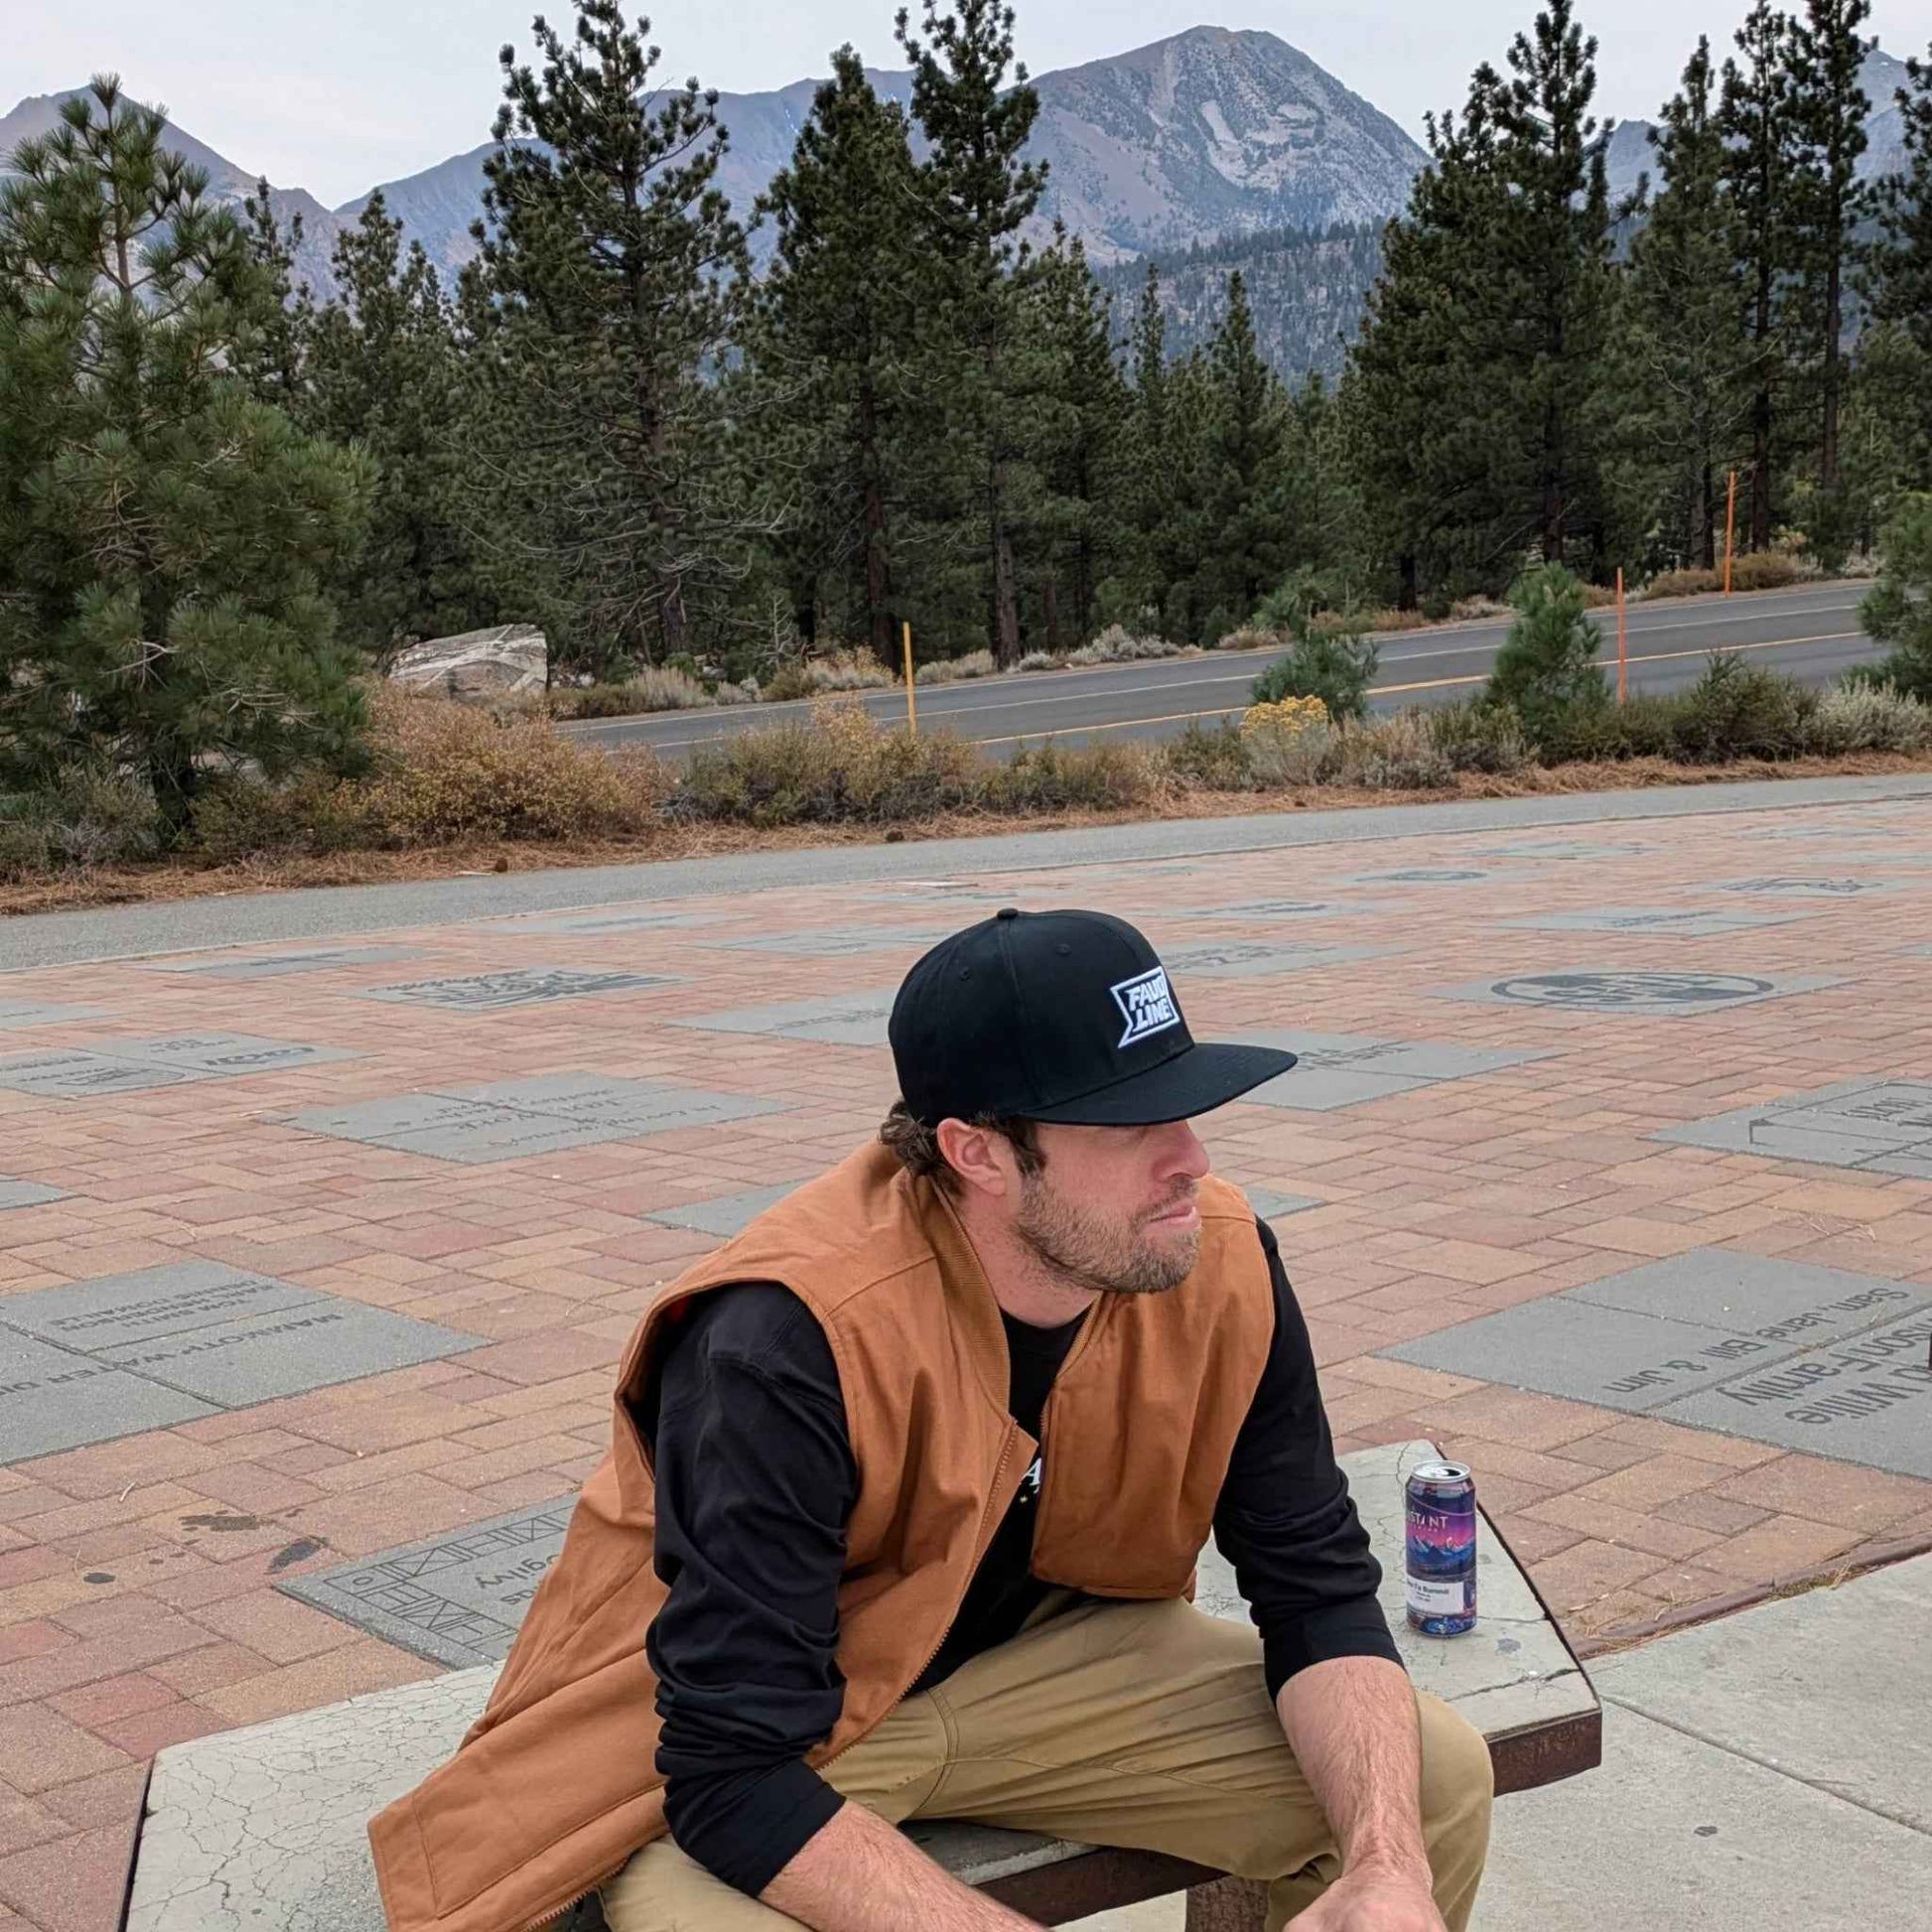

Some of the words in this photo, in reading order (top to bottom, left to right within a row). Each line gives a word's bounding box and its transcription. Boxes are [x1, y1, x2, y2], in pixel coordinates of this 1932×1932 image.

[1132, 997, 1173, 1033] LINE
[182, 1313, 343, 1355] MAMMOTH
[1698, 1338, 1768, 1360] Bill
[47, 1353, 177, 1383] WATER
[1602, 1369, 1675, 1393] Jim
[1660, 1359, 1708, 1372] &
[1716, 1353, 1882, 1407] Family
[1784, 1382, 1925, 1425] Willie
